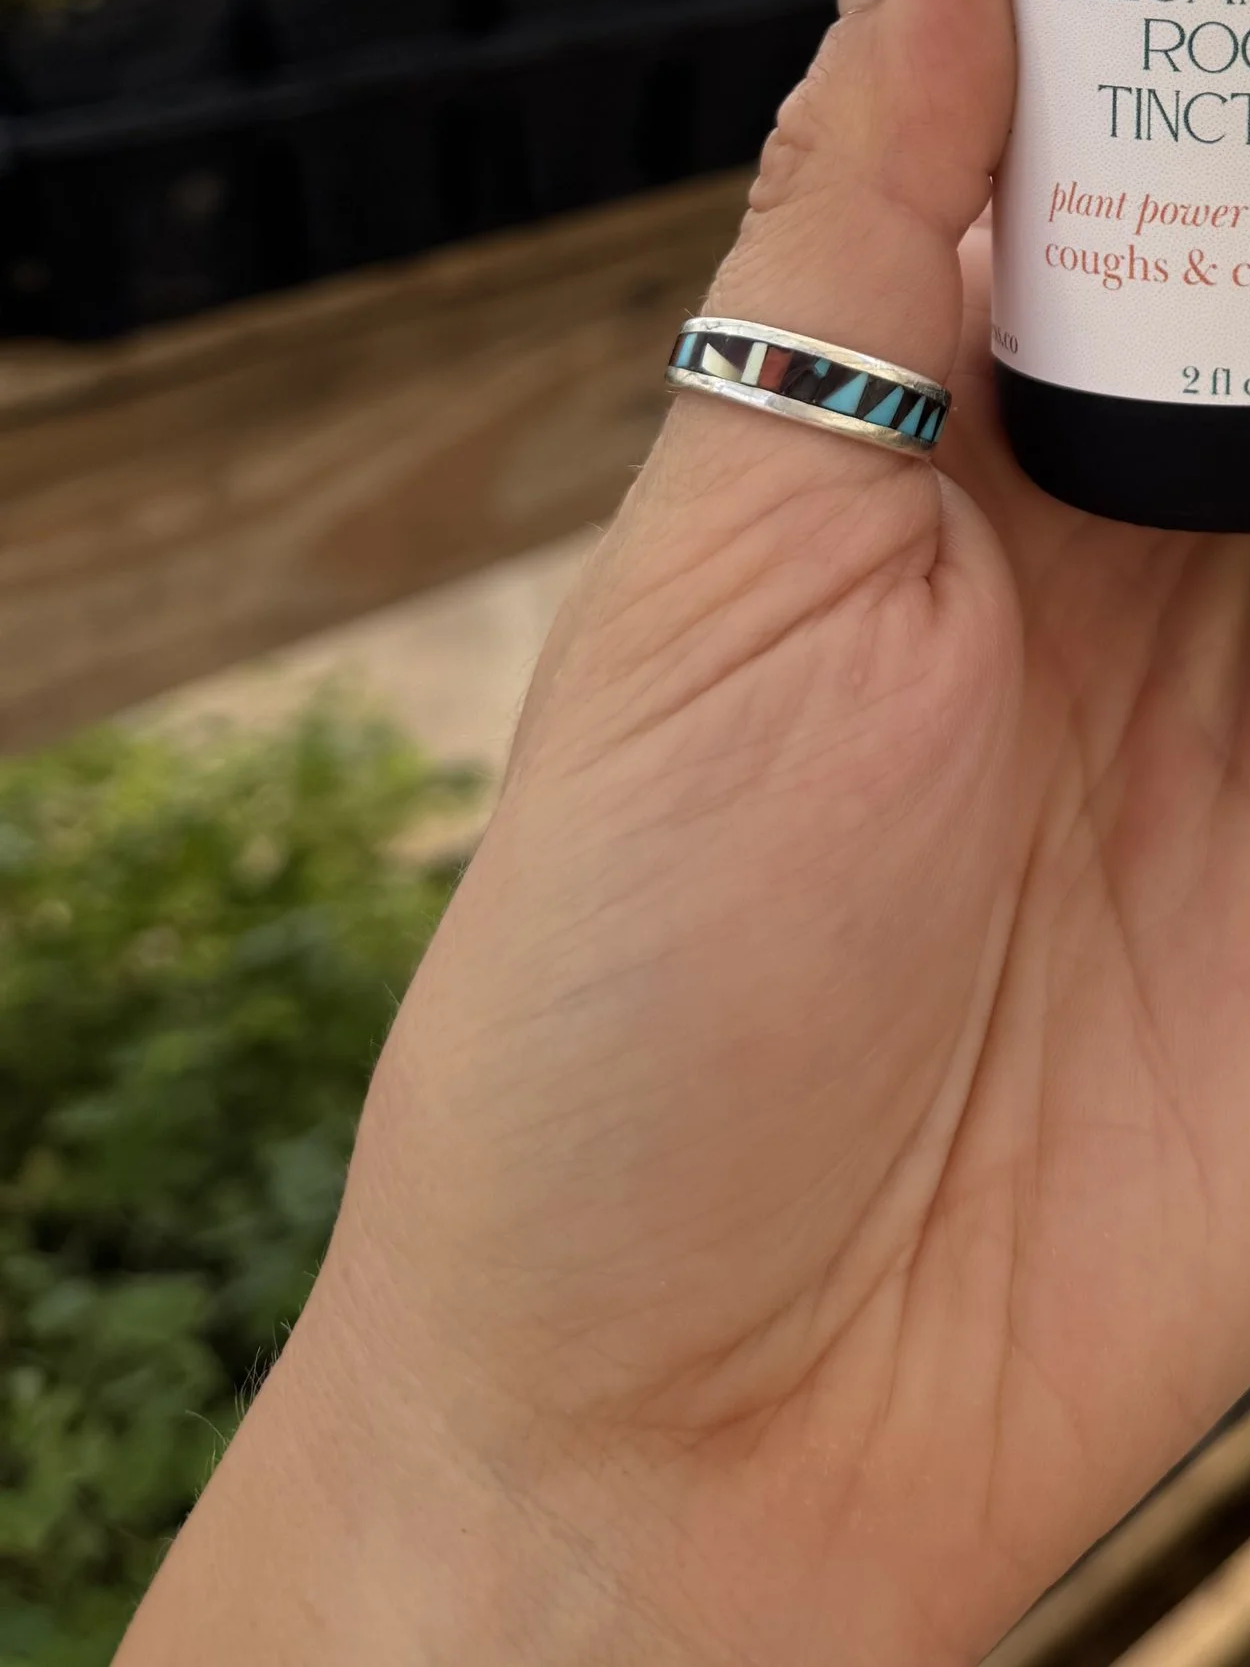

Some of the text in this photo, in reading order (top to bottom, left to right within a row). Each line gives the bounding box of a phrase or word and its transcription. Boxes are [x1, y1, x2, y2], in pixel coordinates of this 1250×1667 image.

[1048, 180, 1127, 223] plant
[1134, 193, 1250, 236] power
[1044, 239, 1170, 291] coughs
[1182, 247, 1219, 287] &
[1181, 365, 1201, 395] 2
[1210, 367, 1232, 397] fl
